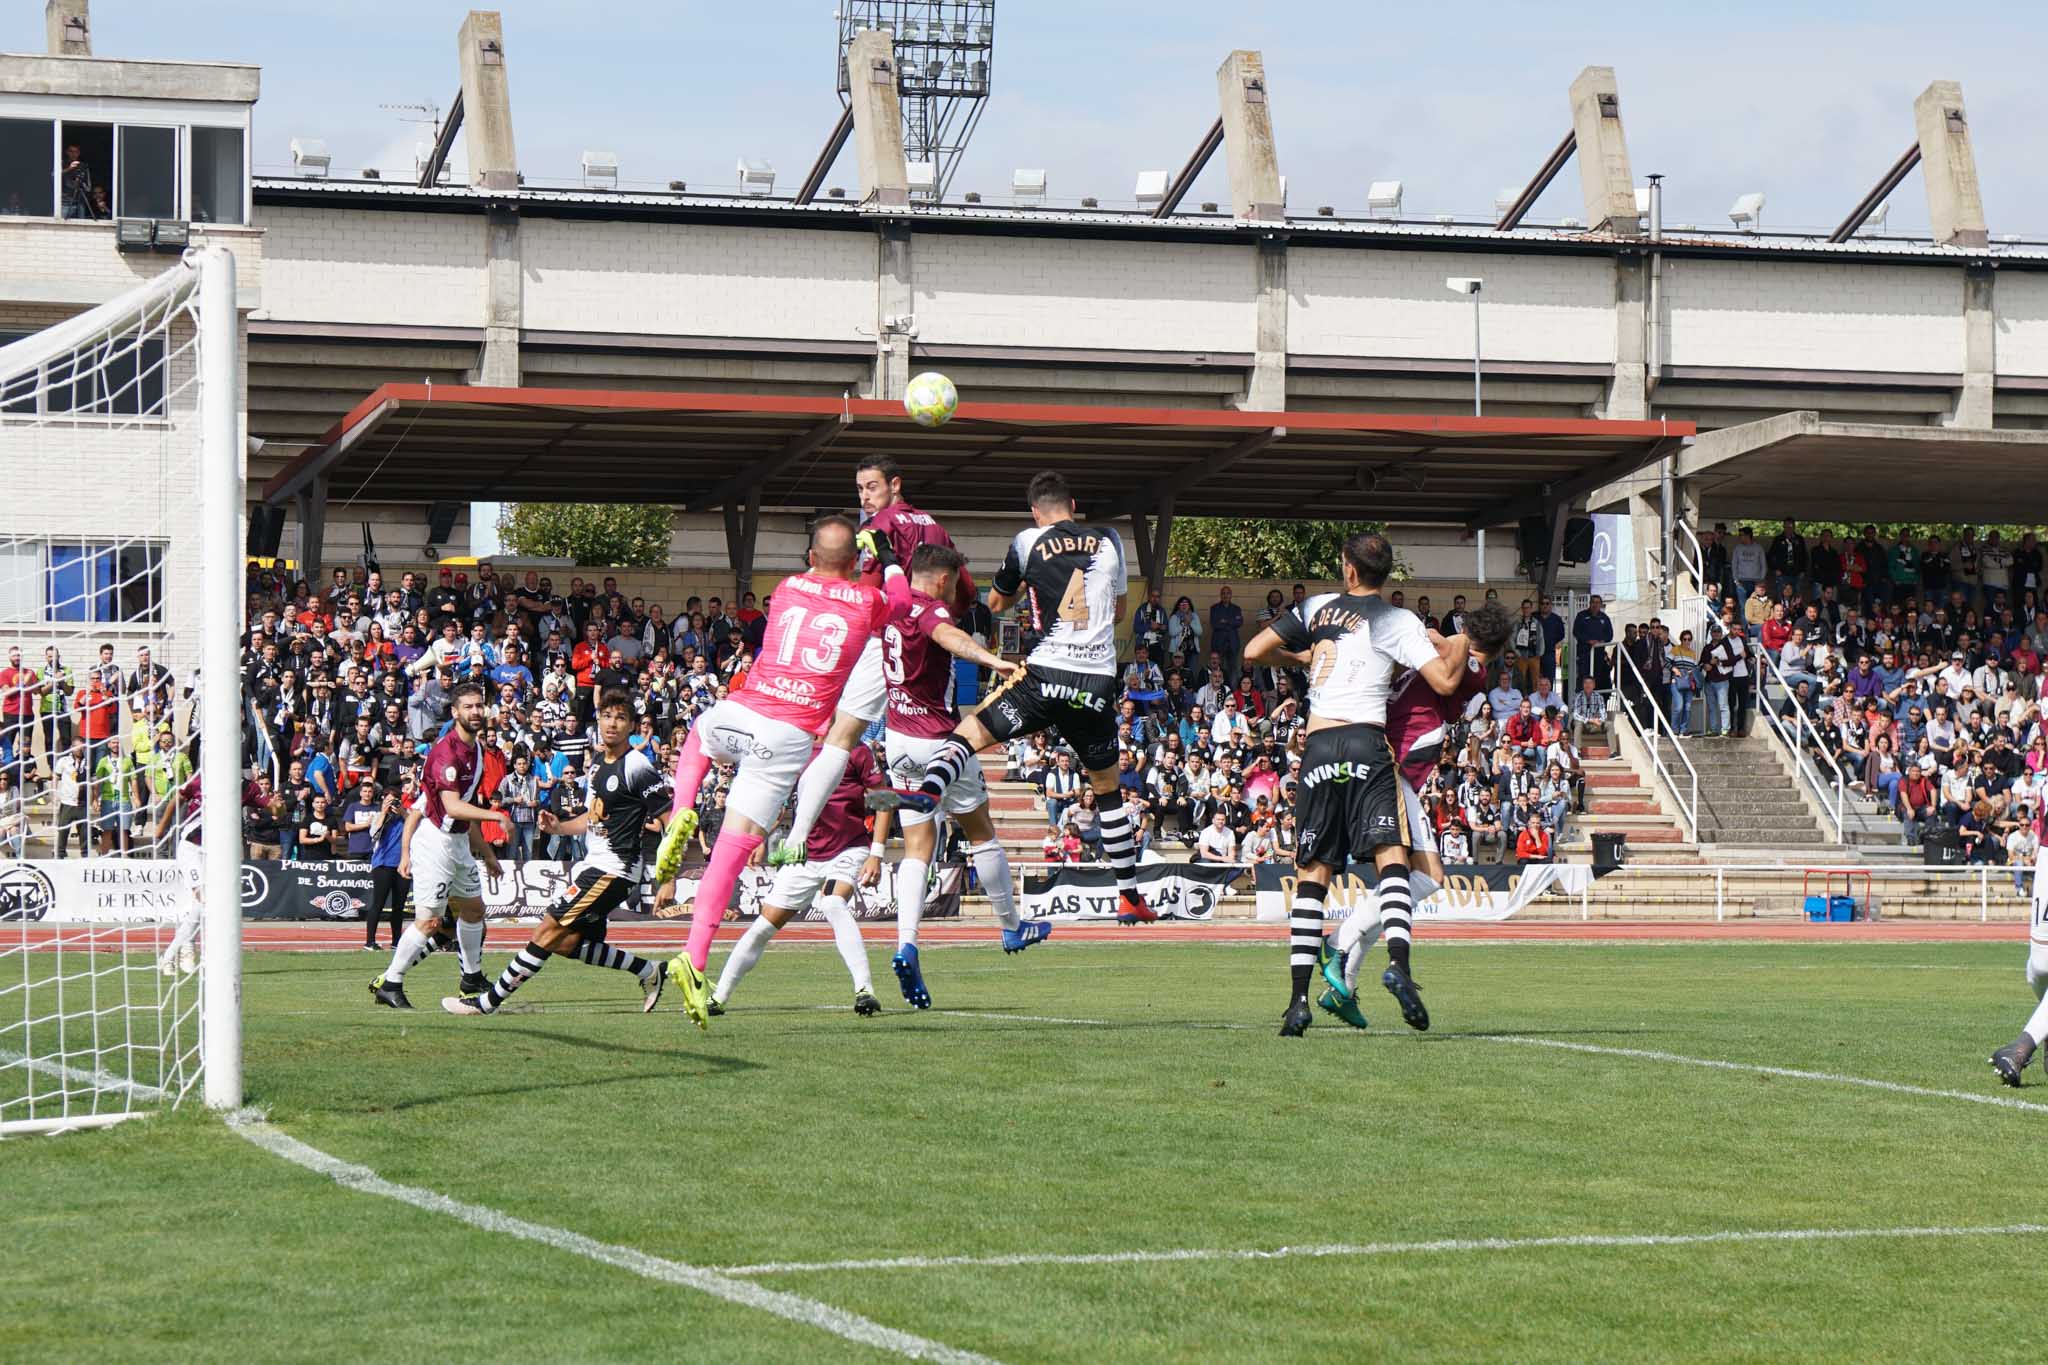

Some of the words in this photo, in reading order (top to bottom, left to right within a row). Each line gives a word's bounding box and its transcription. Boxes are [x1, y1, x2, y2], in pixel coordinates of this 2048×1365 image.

[1057, 567, 1090, 632] 4
[776, 605, 849, 674] 13
[98, 893, 116, 907] DE
[124, 889, 176, 907] PEÑAS
[1030, 889, 1081, 918] LAS
[1086, 886, 1181, 914] VILAS
